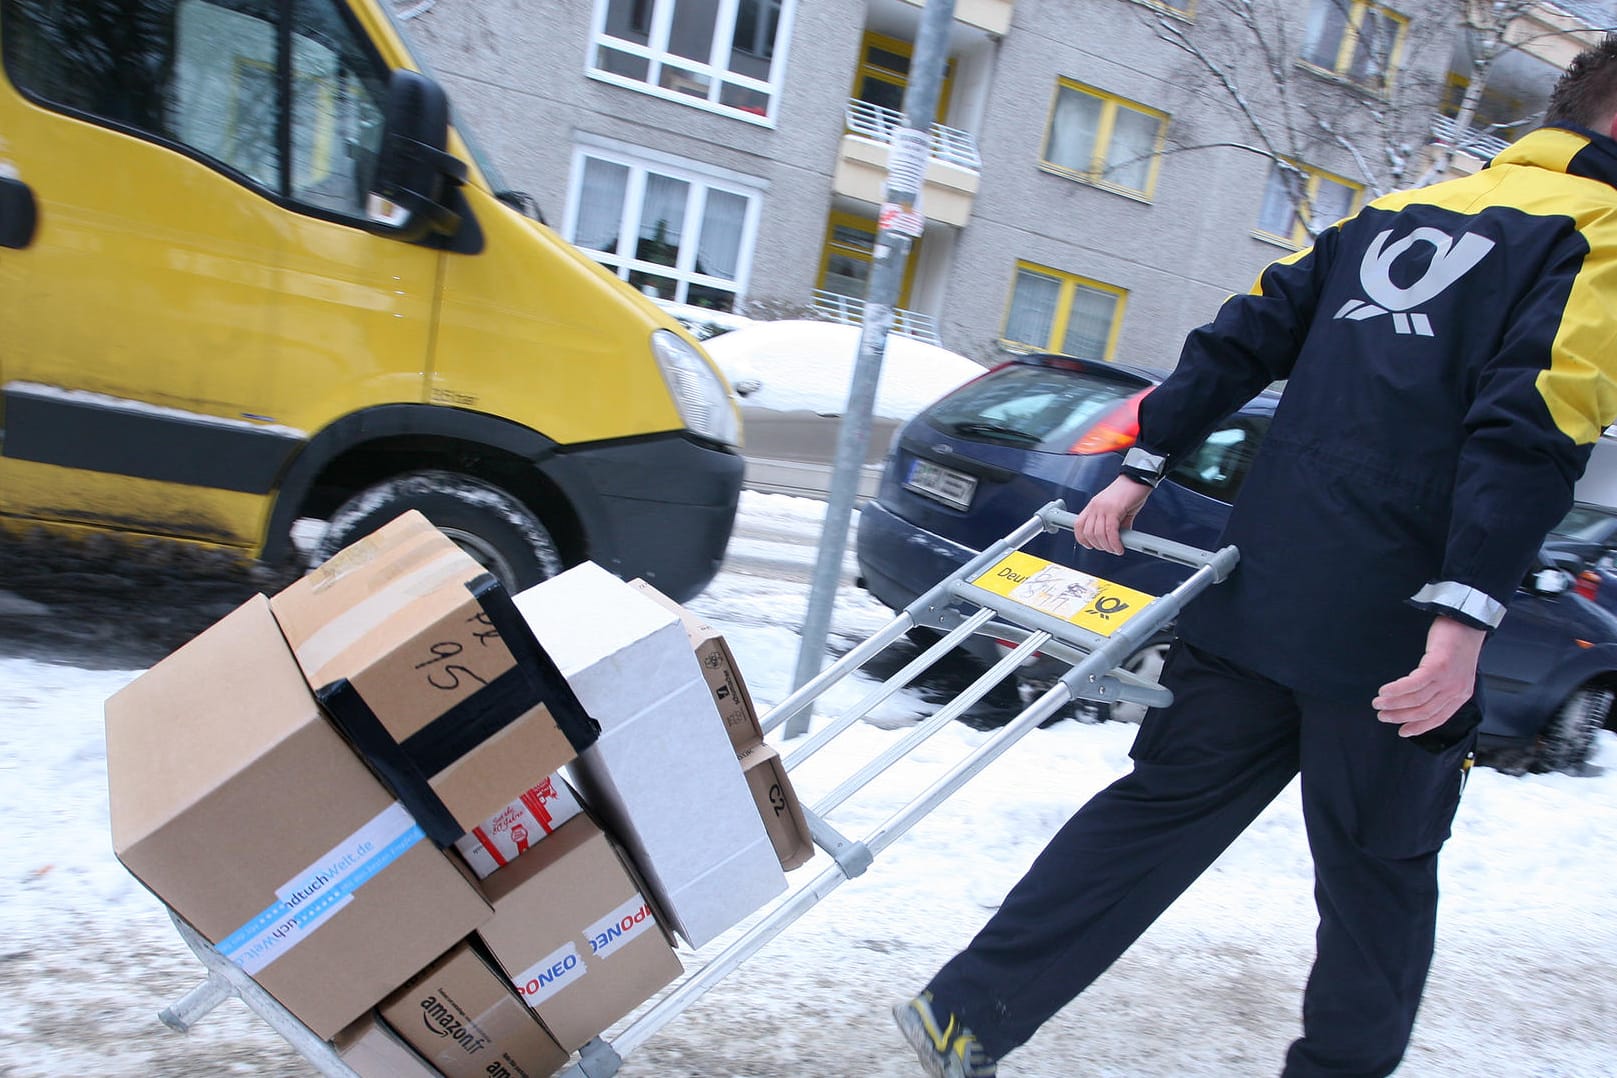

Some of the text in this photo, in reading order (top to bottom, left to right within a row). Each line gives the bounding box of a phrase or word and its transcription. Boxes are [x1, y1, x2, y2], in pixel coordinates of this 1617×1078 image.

[415, 642, 489, 690] 95
[769, 784, 785, 817] C2
[420, 996, 485, 1055] amazon.fr
